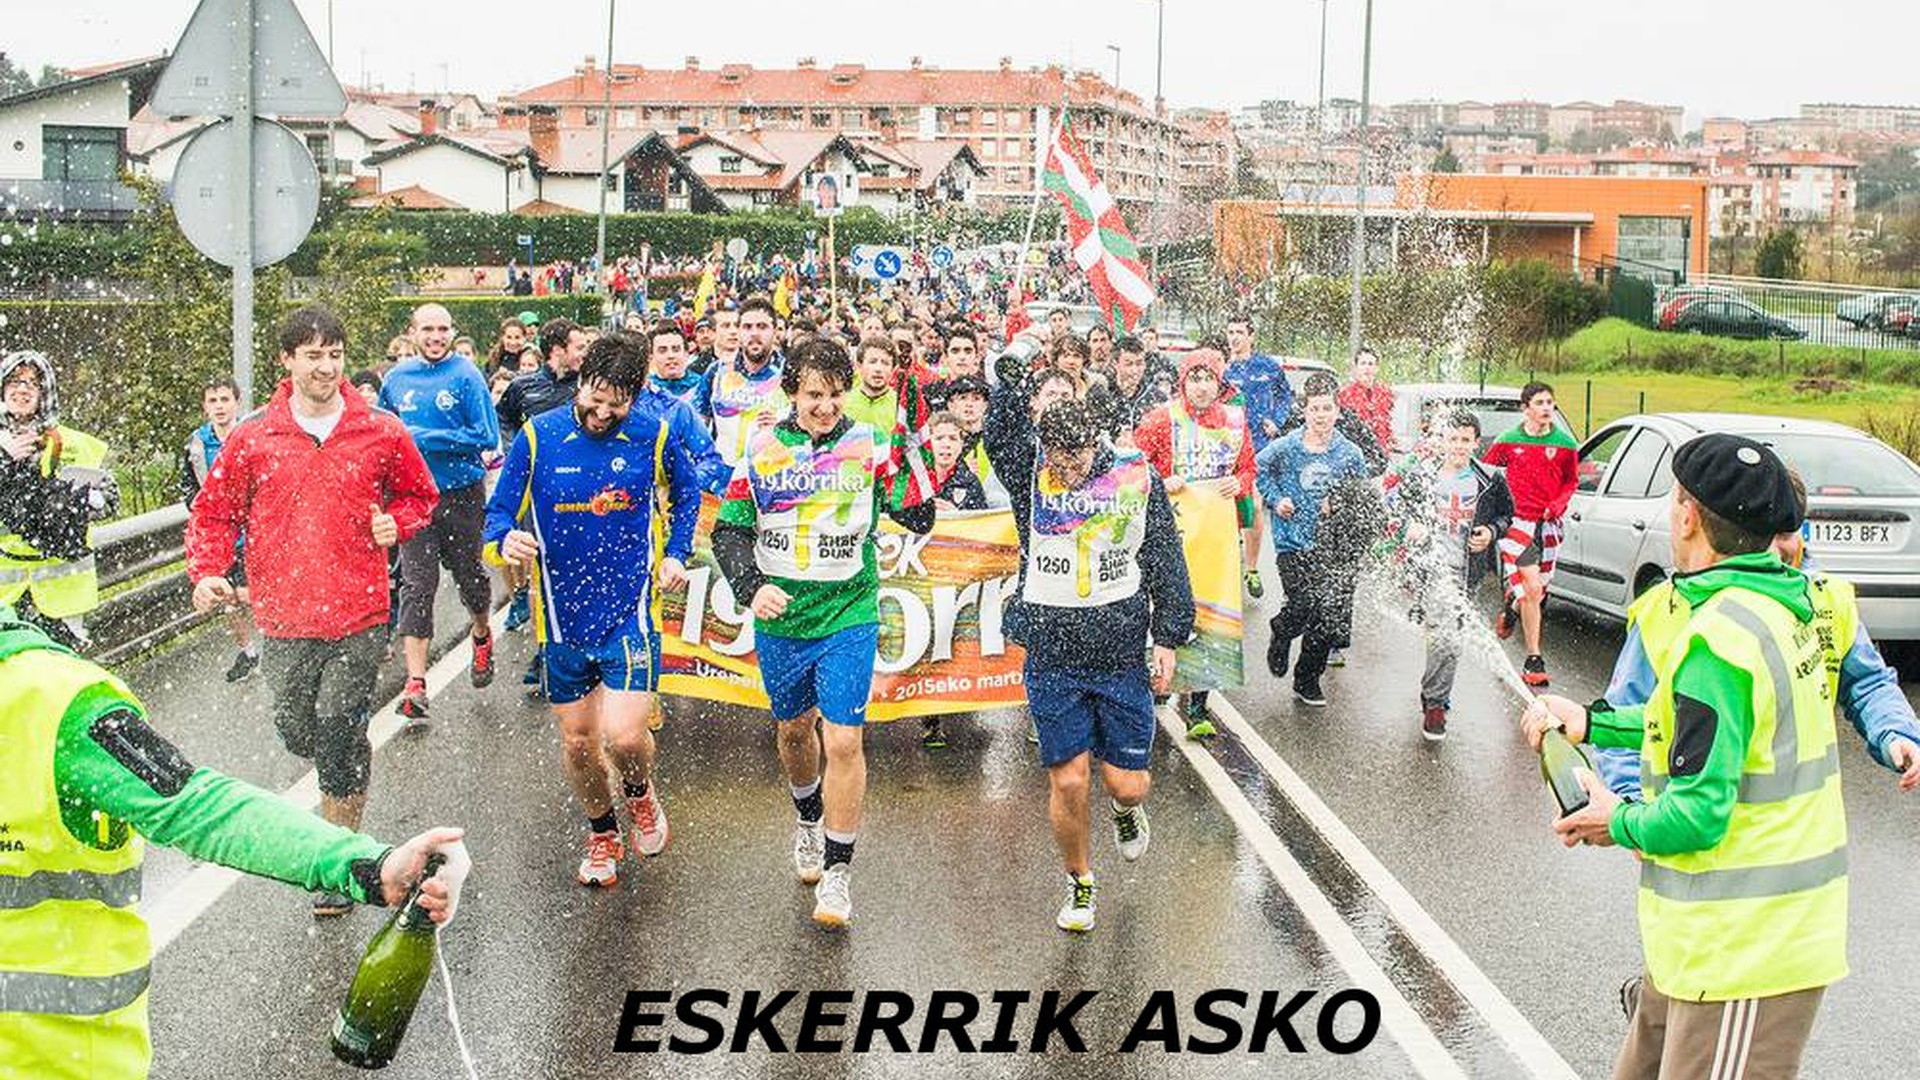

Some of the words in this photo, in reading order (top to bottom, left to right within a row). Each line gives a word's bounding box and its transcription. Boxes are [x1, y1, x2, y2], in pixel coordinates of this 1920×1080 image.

[1815, 525, 1852, 541] 1123
[1036, 555, 1071, 575] 1250
[894, 675, 972, 701] 2015eko
